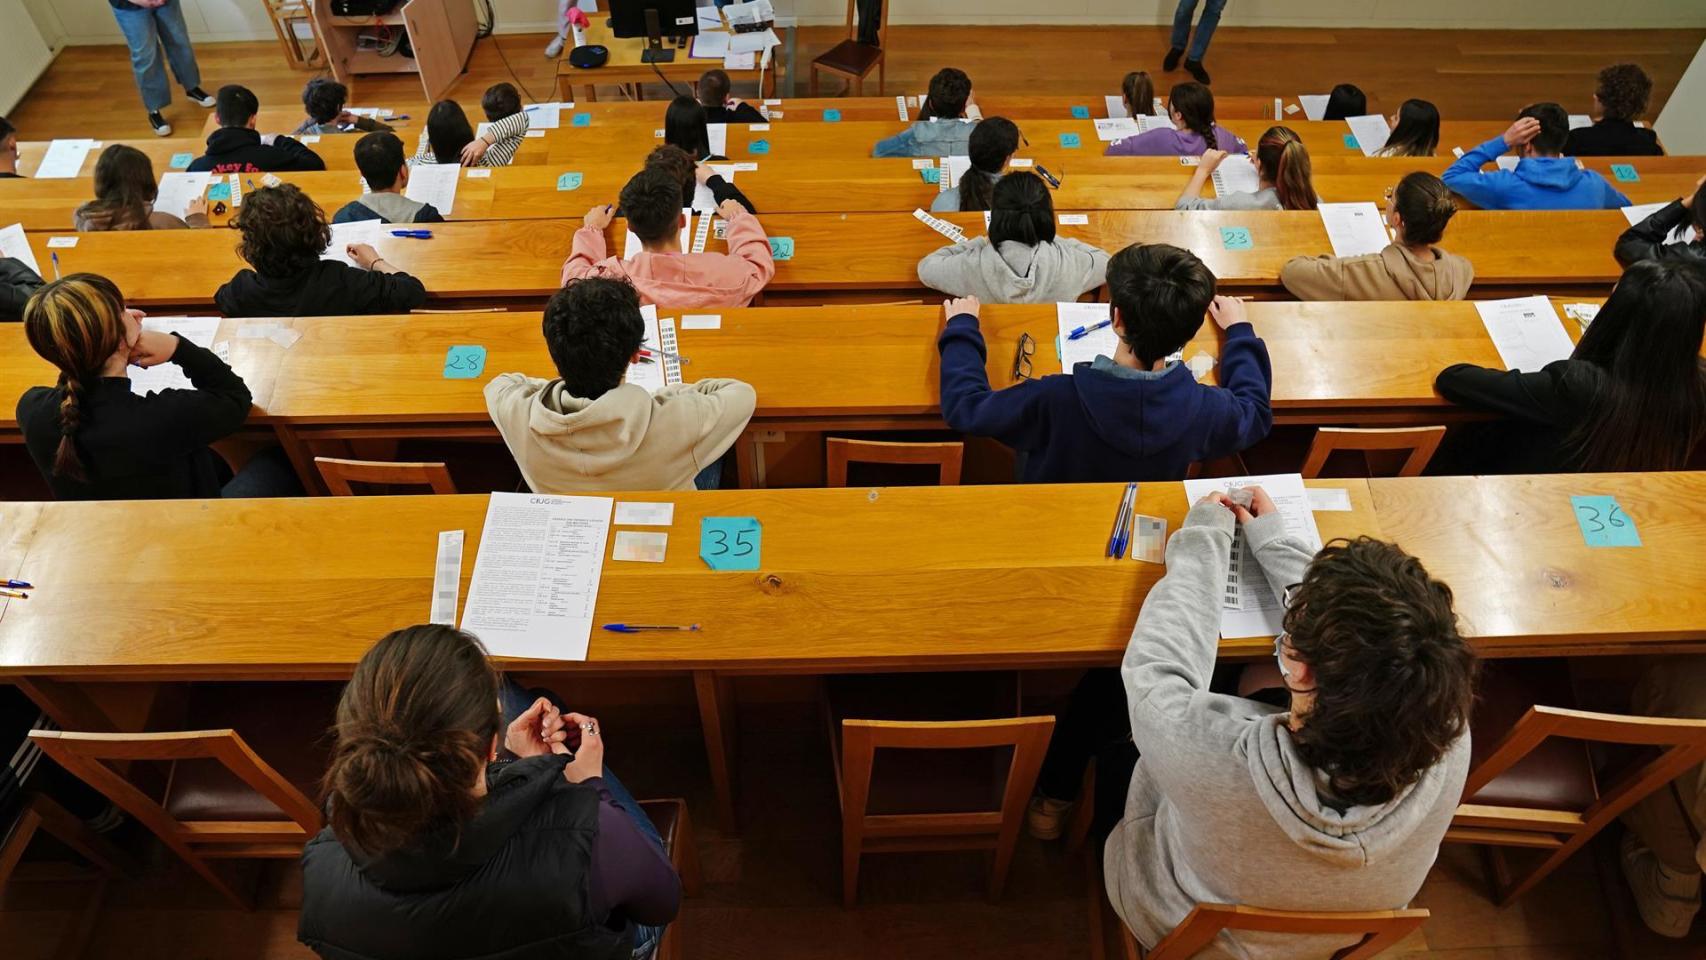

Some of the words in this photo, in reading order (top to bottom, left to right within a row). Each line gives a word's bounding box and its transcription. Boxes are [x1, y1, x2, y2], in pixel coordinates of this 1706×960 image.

[1223, 231, 1248, 245] 23
[445, 354, 481, 370] 28
[1578, 504, 1625, 533] 36
[708, 528, 757, 557] 35
